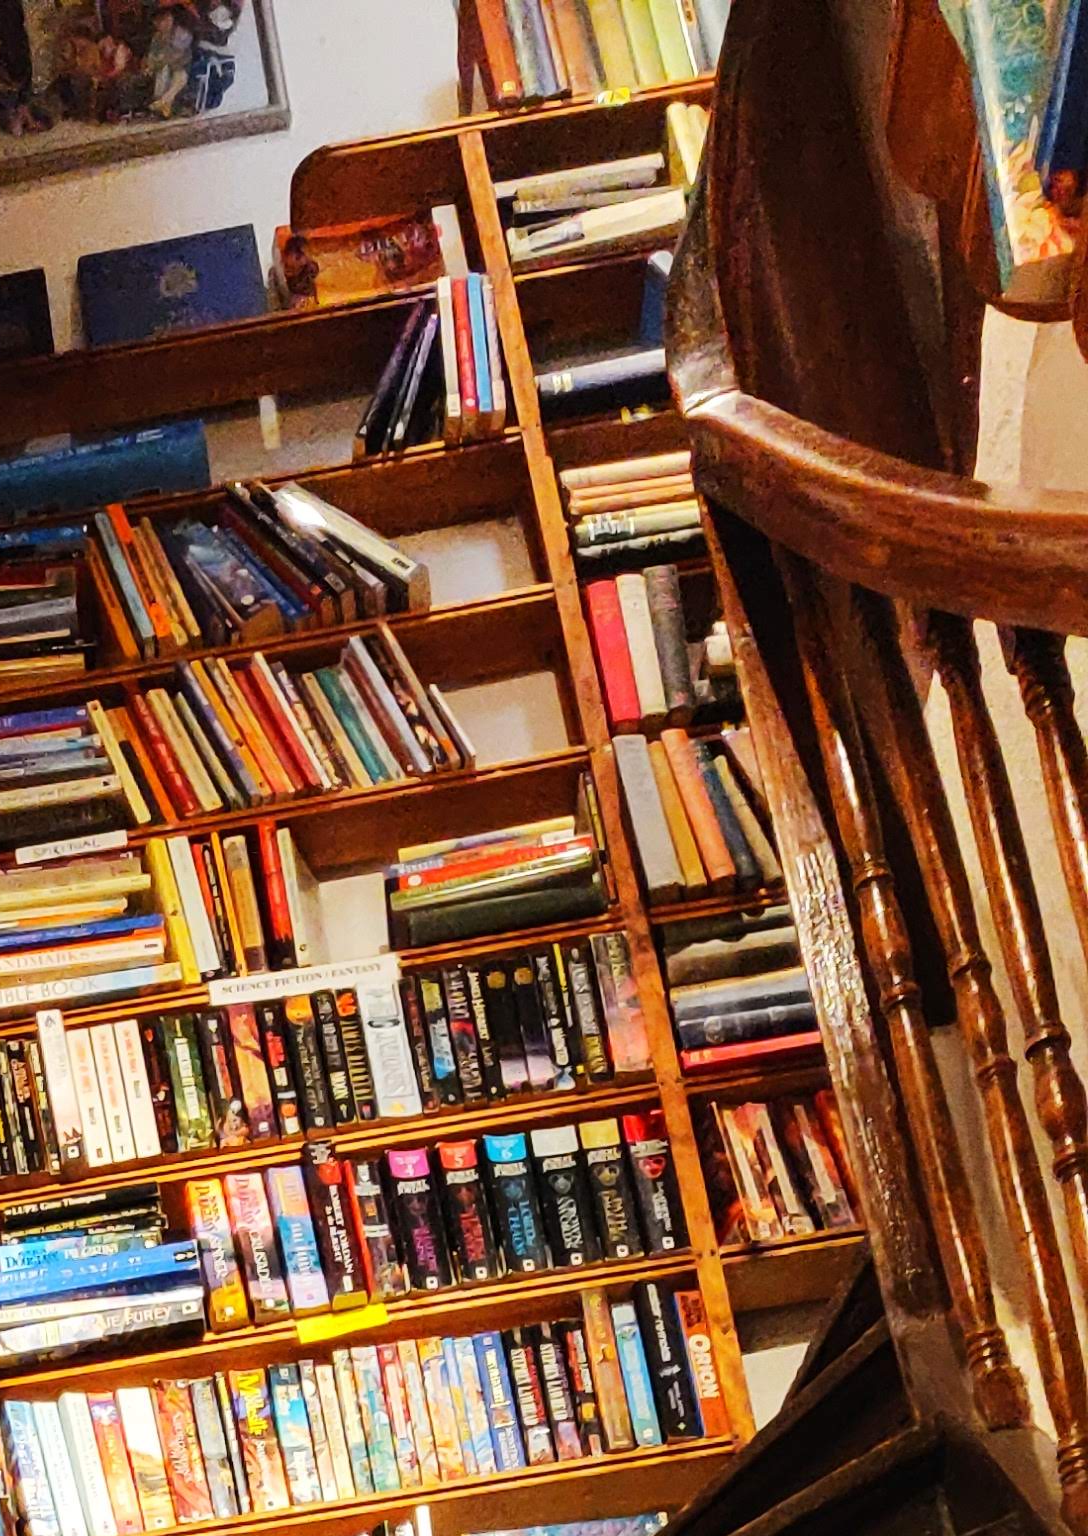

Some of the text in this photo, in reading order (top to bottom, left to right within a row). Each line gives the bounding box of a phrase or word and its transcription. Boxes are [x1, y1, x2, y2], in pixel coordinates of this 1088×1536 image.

[40, 976, 99, 999] BOOK
[222, 980, 272, 993] SCIENCE
[275, 973, 322, 988] FICTION
[331, 963, 382, 978] FANTASY
[689, 1334, 720, 1400] ORION
